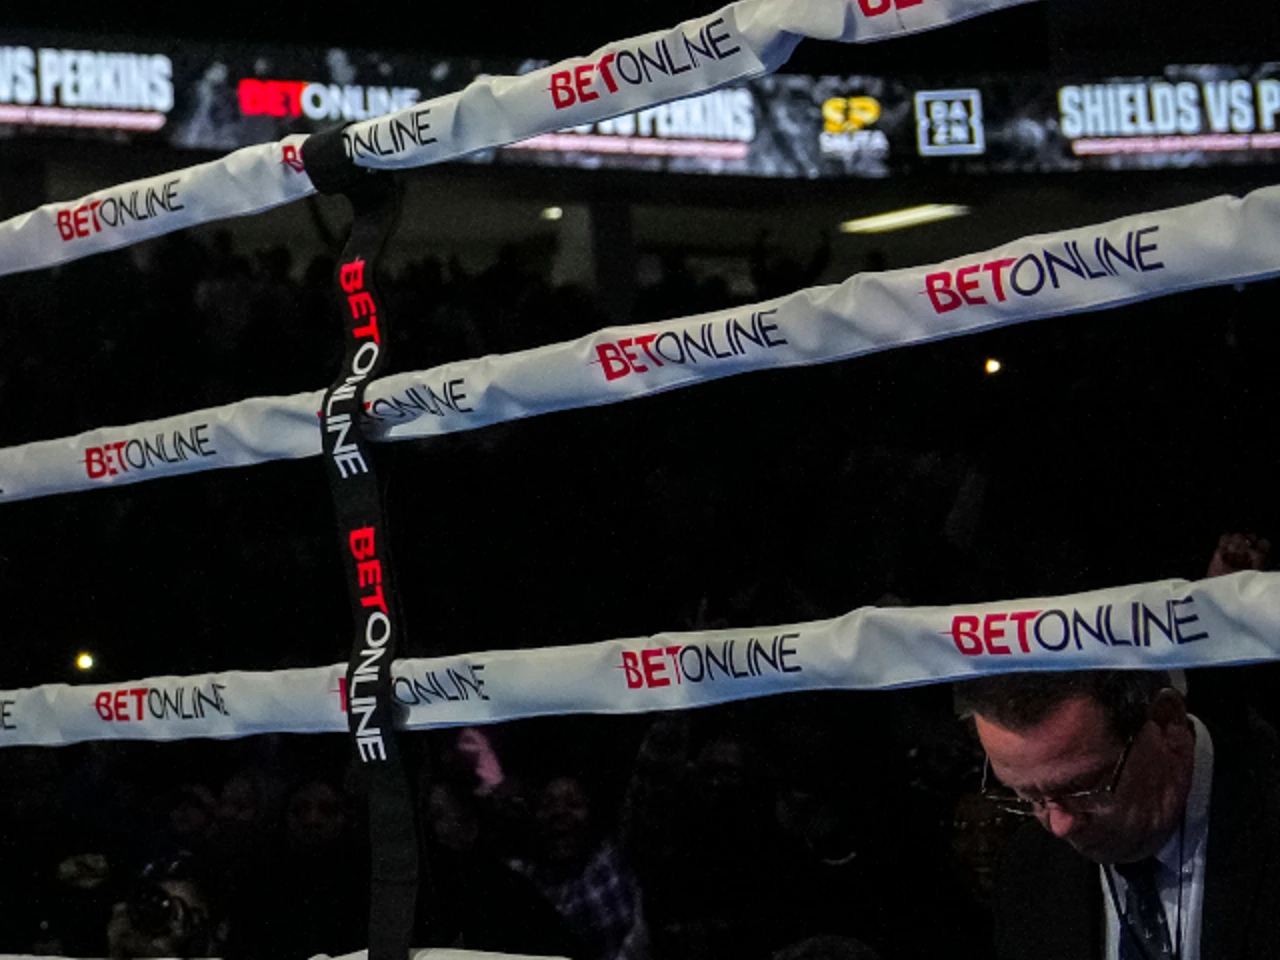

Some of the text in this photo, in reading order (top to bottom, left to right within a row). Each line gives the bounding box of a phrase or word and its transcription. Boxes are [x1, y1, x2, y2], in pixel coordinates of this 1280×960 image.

[40, 47, 173, 113] PERKINS
[1059, 82, 1199, 138] SHIELDS
[1206, 81, 1255, 136] VS
[56, 180, 185, 241] BETONLINE
[924, 225, 1164, 315] BETONLINE
[326, 259, 381, 479] BETONLINE
[594, 309, 786, 381] BETONLINE
[84, 424, 215, 479] BETONLINE
[349, 526, 391, 763] BETONLINE
[950, 596, 1208, 656] BETONLINE
[622, 633, 801, 689] BETONLINE
[97, 682, 230, 721] BETONLINE
